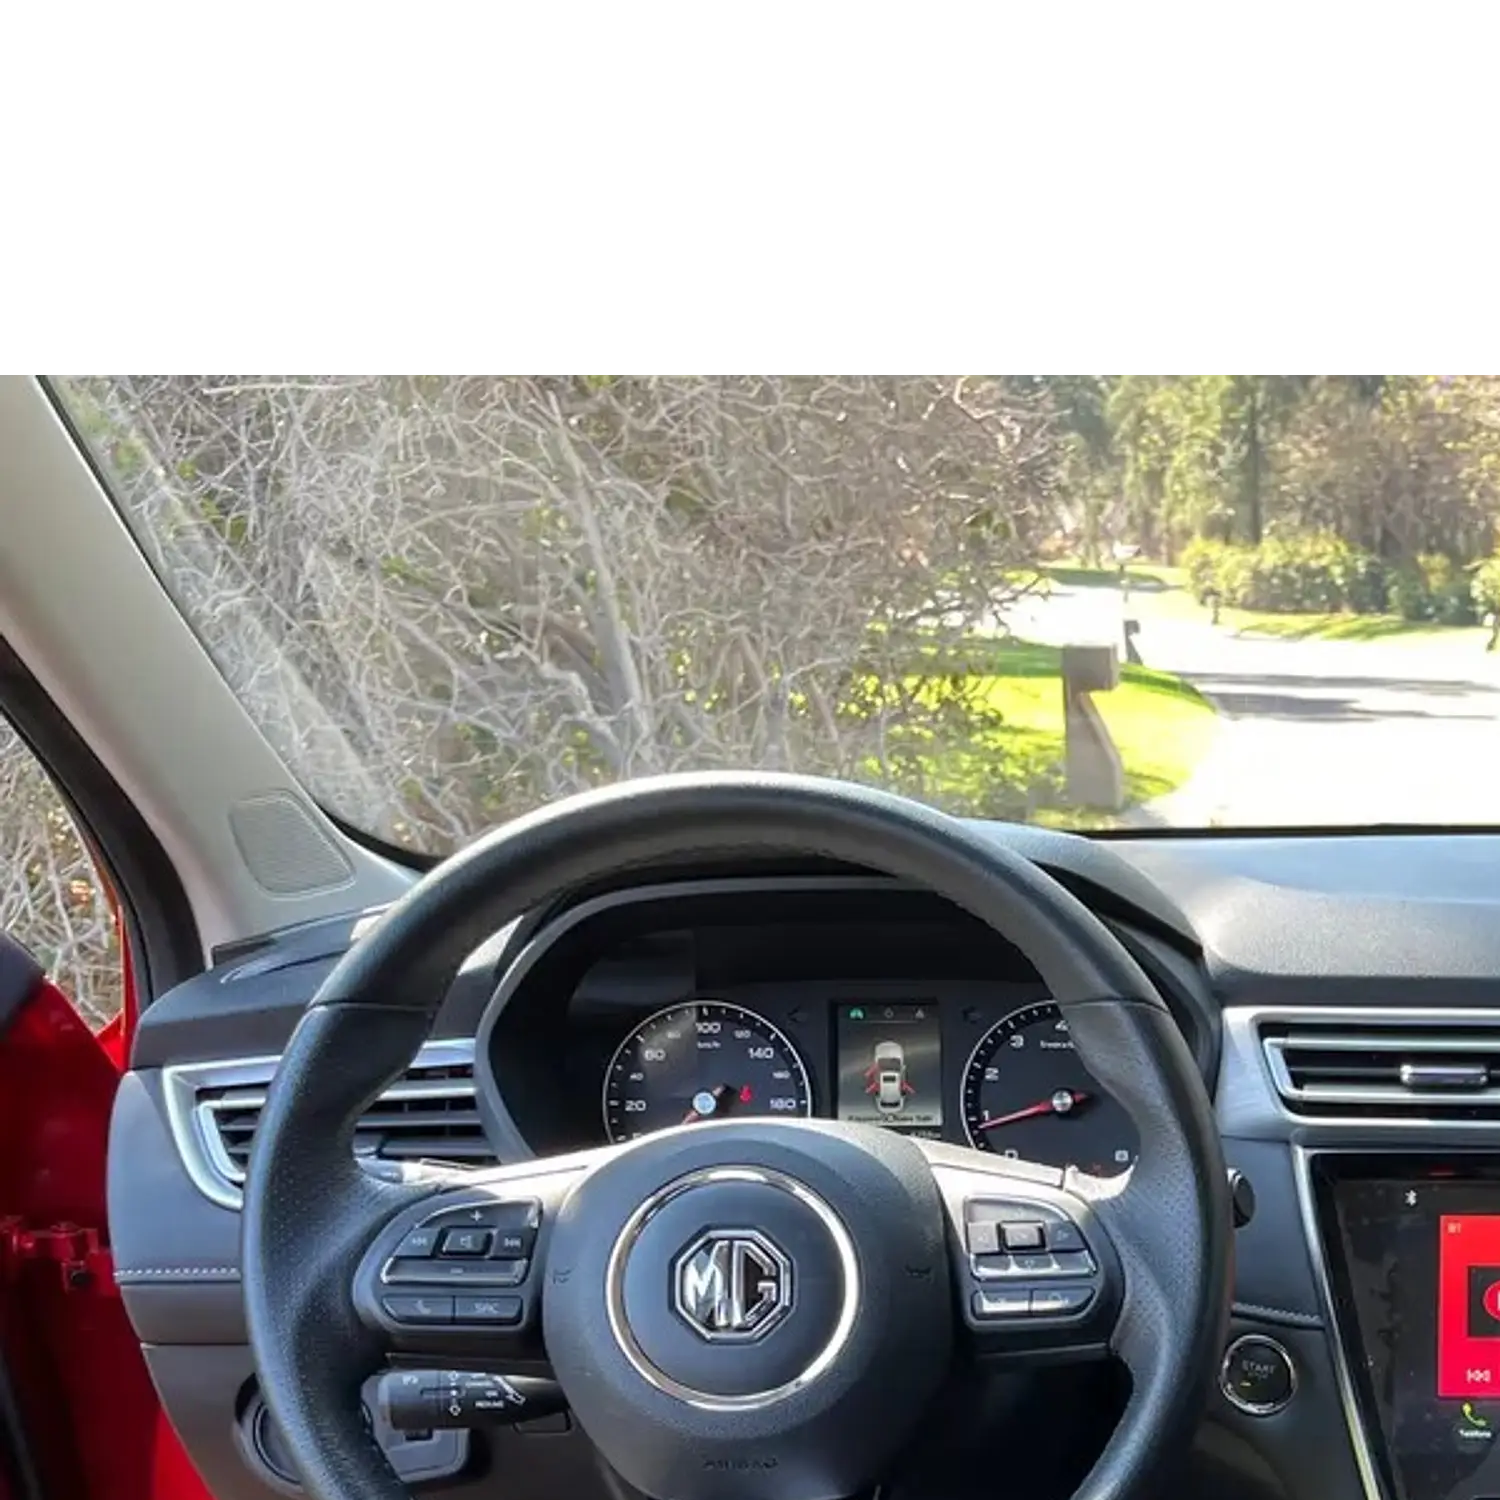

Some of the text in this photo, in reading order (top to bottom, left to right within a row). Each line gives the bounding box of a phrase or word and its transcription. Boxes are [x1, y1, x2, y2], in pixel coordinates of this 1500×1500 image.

[695, 1022, 721, 1033] 100
[1010, 1035, 1024, 1048] 3
[643, 1049, 666, 1061] 60
[749, 1048, 774, 1060] 140
[985, 1067, 999, 1081] 2
[625, 1100, 646, 1111] 20
[683, 1240, 776, 1327] MG
